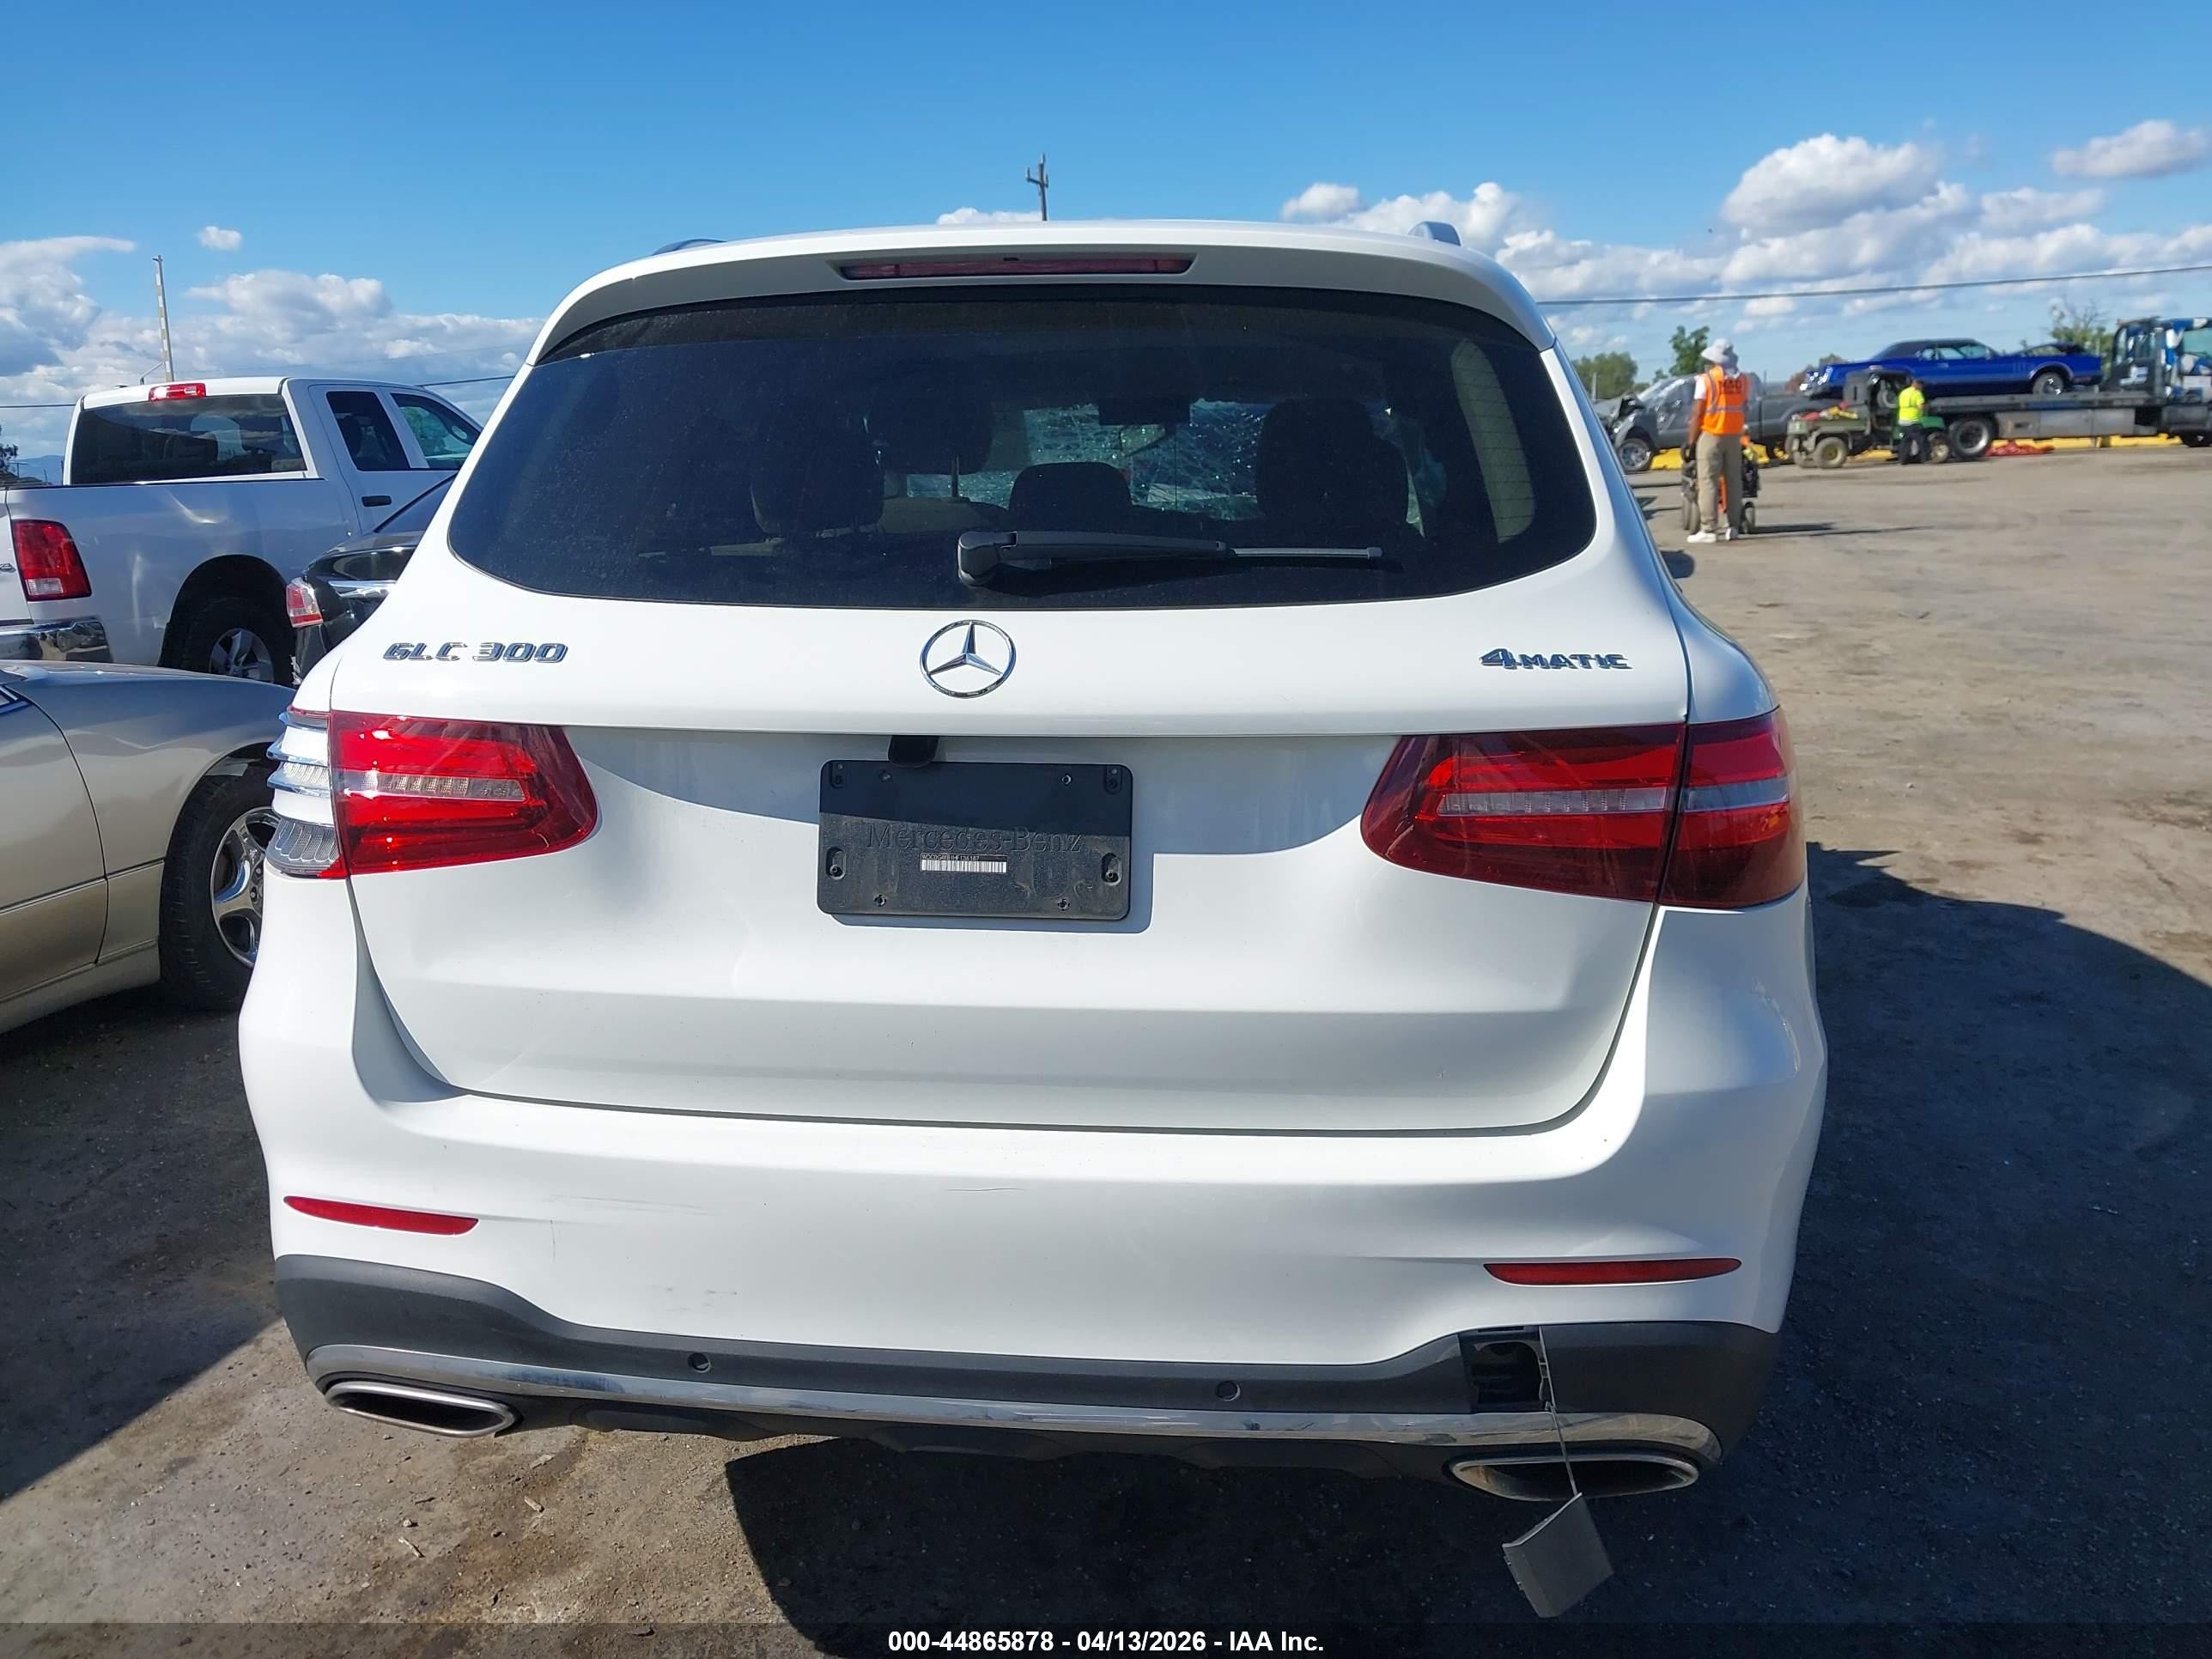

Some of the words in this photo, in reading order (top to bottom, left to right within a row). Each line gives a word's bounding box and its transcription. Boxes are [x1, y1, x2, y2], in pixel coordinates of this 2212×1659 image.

[383, 642, 468, 661] GLC
[472, 642, 568, 663] 300
[1479, 648, 1633, 670] 4MATIC
[866, 823, 1083, 853] Mercedes-Benz
